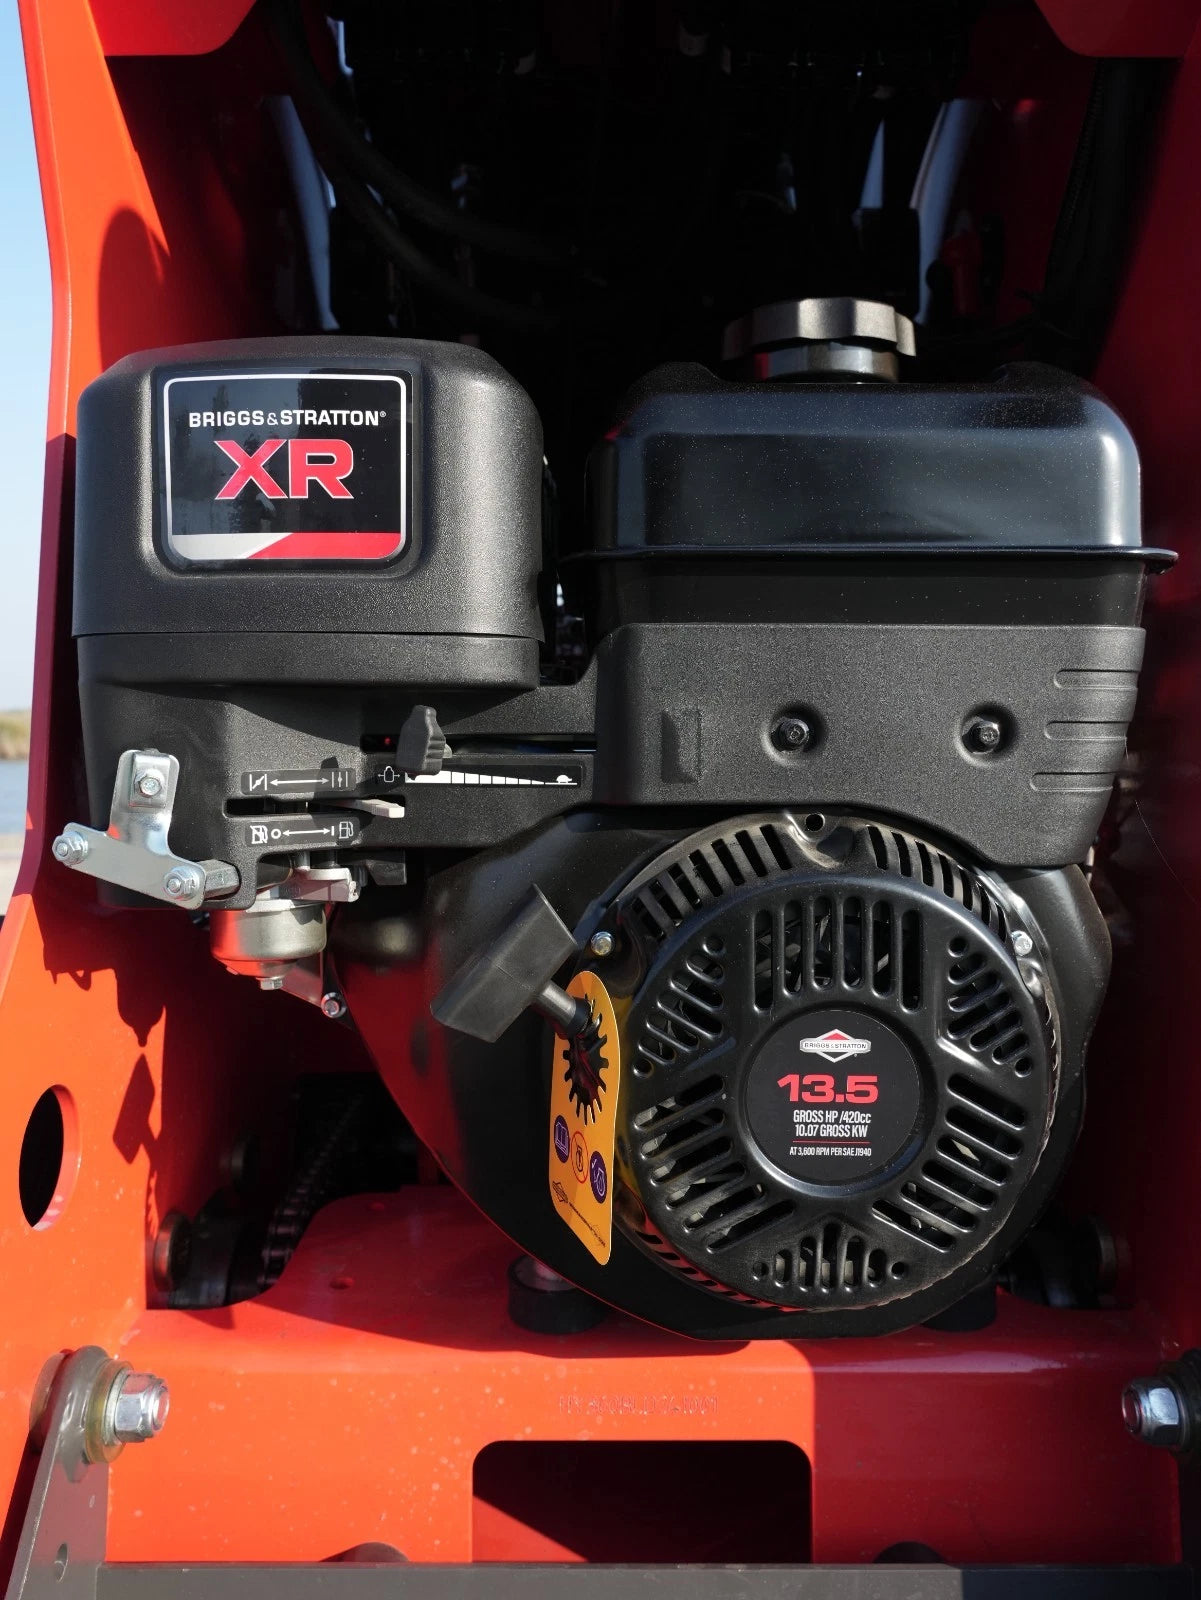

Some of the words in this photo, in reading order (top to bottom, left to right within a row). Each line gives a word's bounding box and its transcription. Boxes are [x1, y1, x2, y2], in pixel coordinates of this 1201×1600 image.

[213, 438, 355, 500] XR
[777, 1073, 879, 1104] 13.5
[793, 1109, 824, 1123] GROSS
[825, 1110, 839, 1123] HP
[839, 1110, 872, 1124] /420cc
[795, 1124, 819, 1137] 10.07
[820, 1124, 850, 1137] GROSS
[851, 1124, 868, 1138] KW
[789, 1147, 797, 1156] AT
[798, 1147, 815, 1157] 3,600
[815, 1147, 830, 1156] RPM
[830, 1147, 842, 1156] PER
[842, 1147, 854, 1156] SAE
[854, 1147, 872, 1157] J1940
